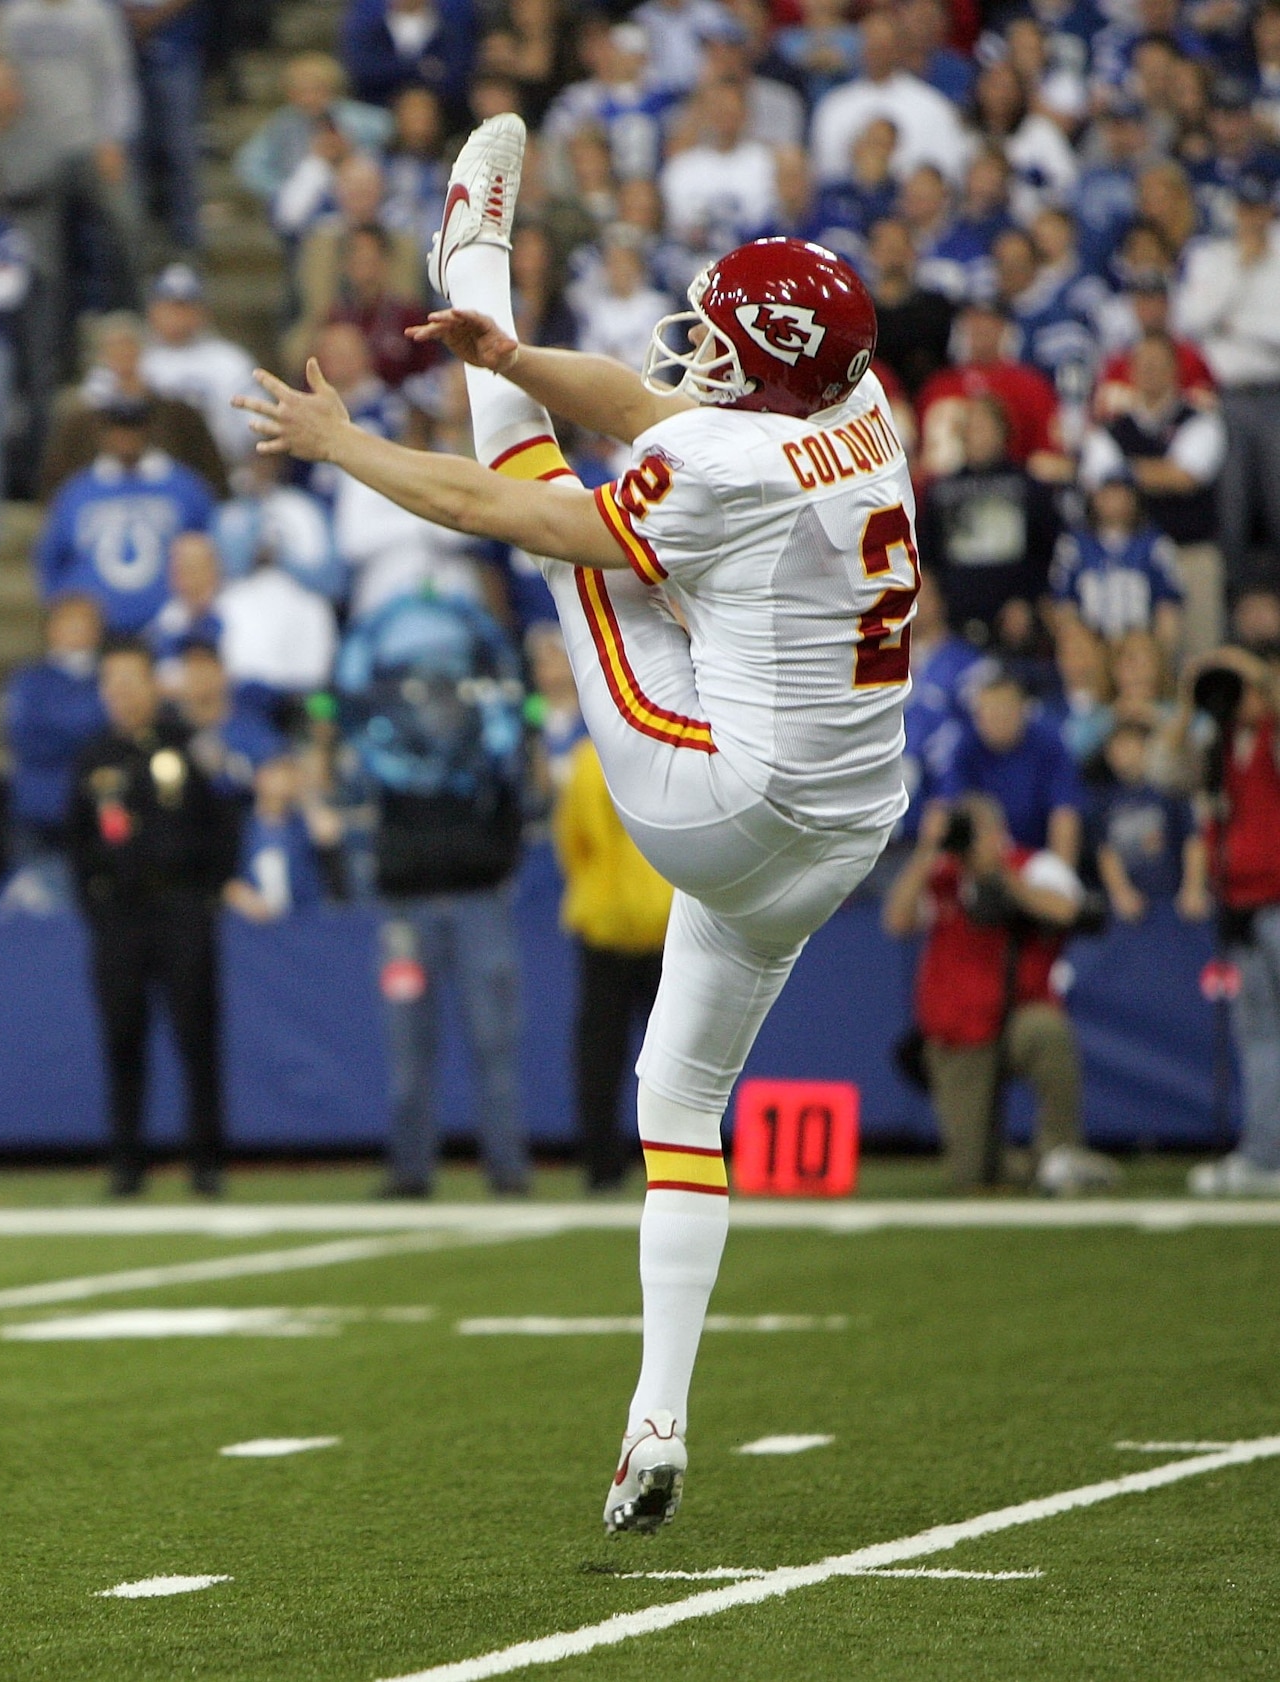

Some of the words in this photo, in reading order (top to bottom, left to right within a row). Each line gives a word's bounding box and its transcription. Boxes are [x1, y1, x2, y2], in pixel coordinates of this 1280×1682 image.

[620, 453, 674, 523] 2
[852, 501, 923, 690] 2
[763, 1105, 833, 1179] 10
